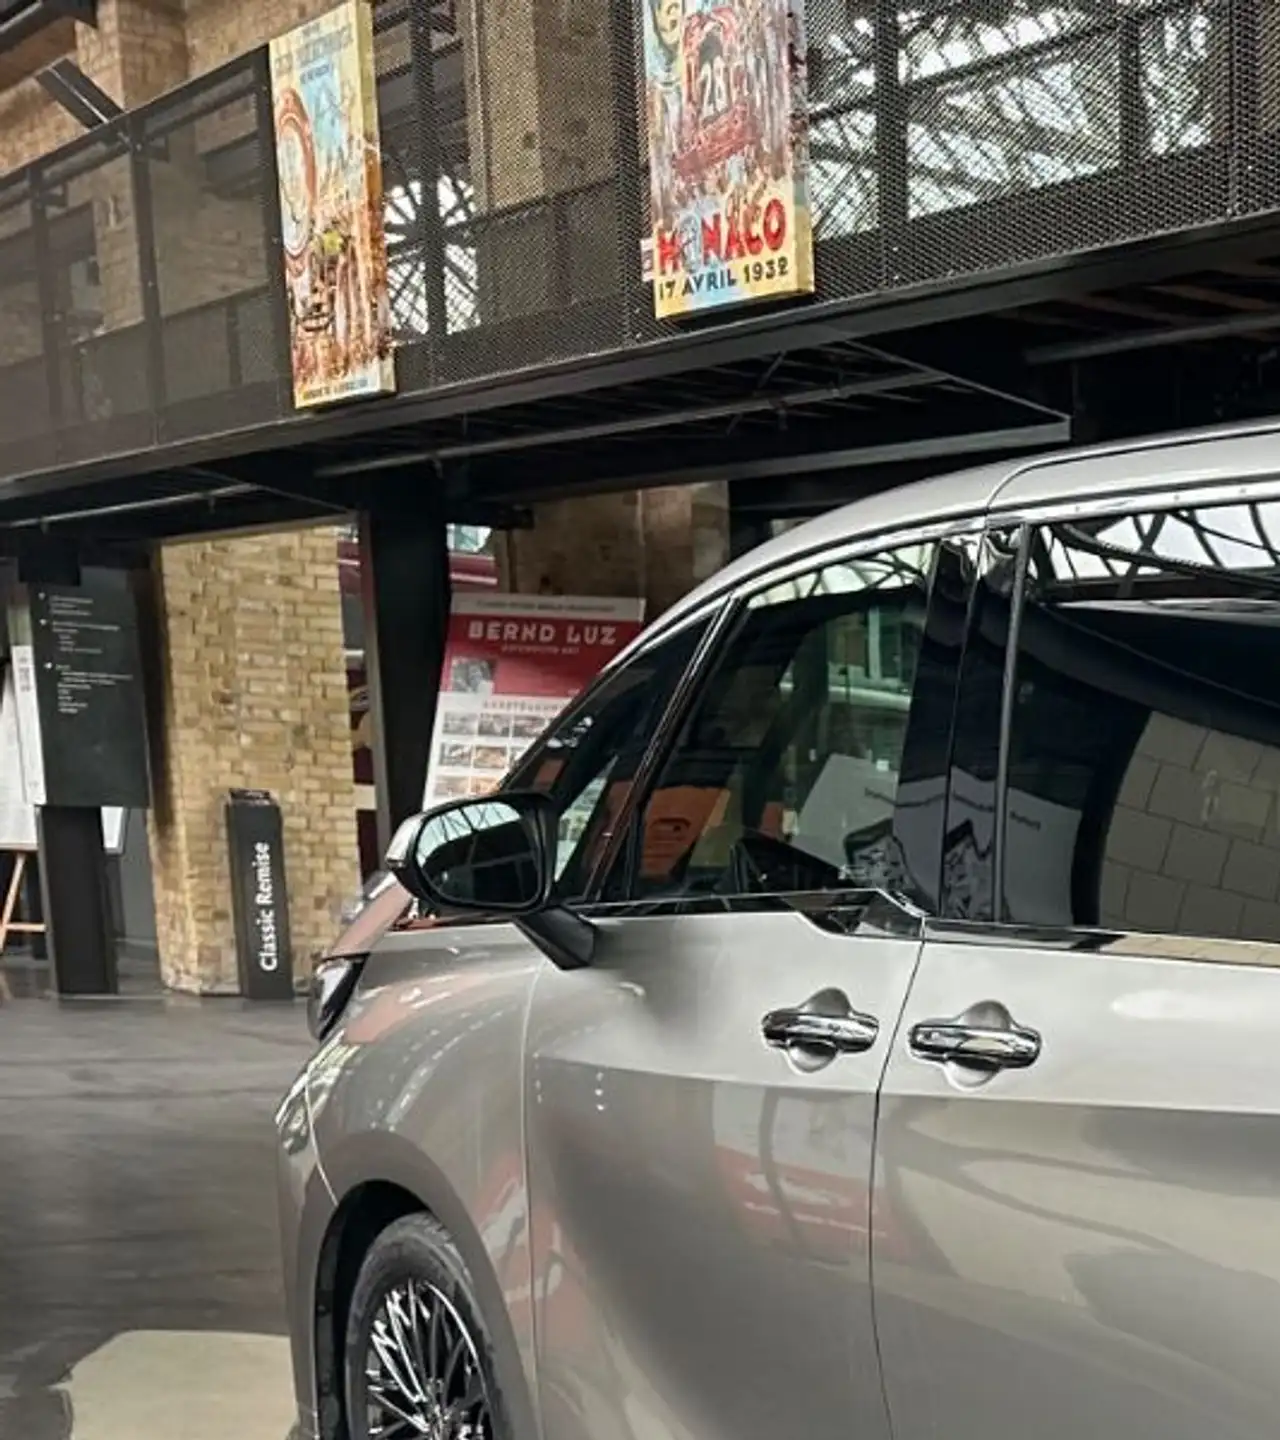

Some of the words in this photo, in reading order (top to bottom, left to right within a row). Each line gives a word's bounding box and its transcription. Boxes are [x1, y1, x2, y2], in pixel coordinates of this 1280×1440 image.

[659, 281, 676, 300] 17
[682, 268, 738, 297] AVRIL
[743, 256, 789, 284] 1932
[468, 620, 556, 643] BERND
[567, 624, 617, 646] LUZ
[252, 841, 274, 905] Remise
[258, 909, 278, 972] Classic
